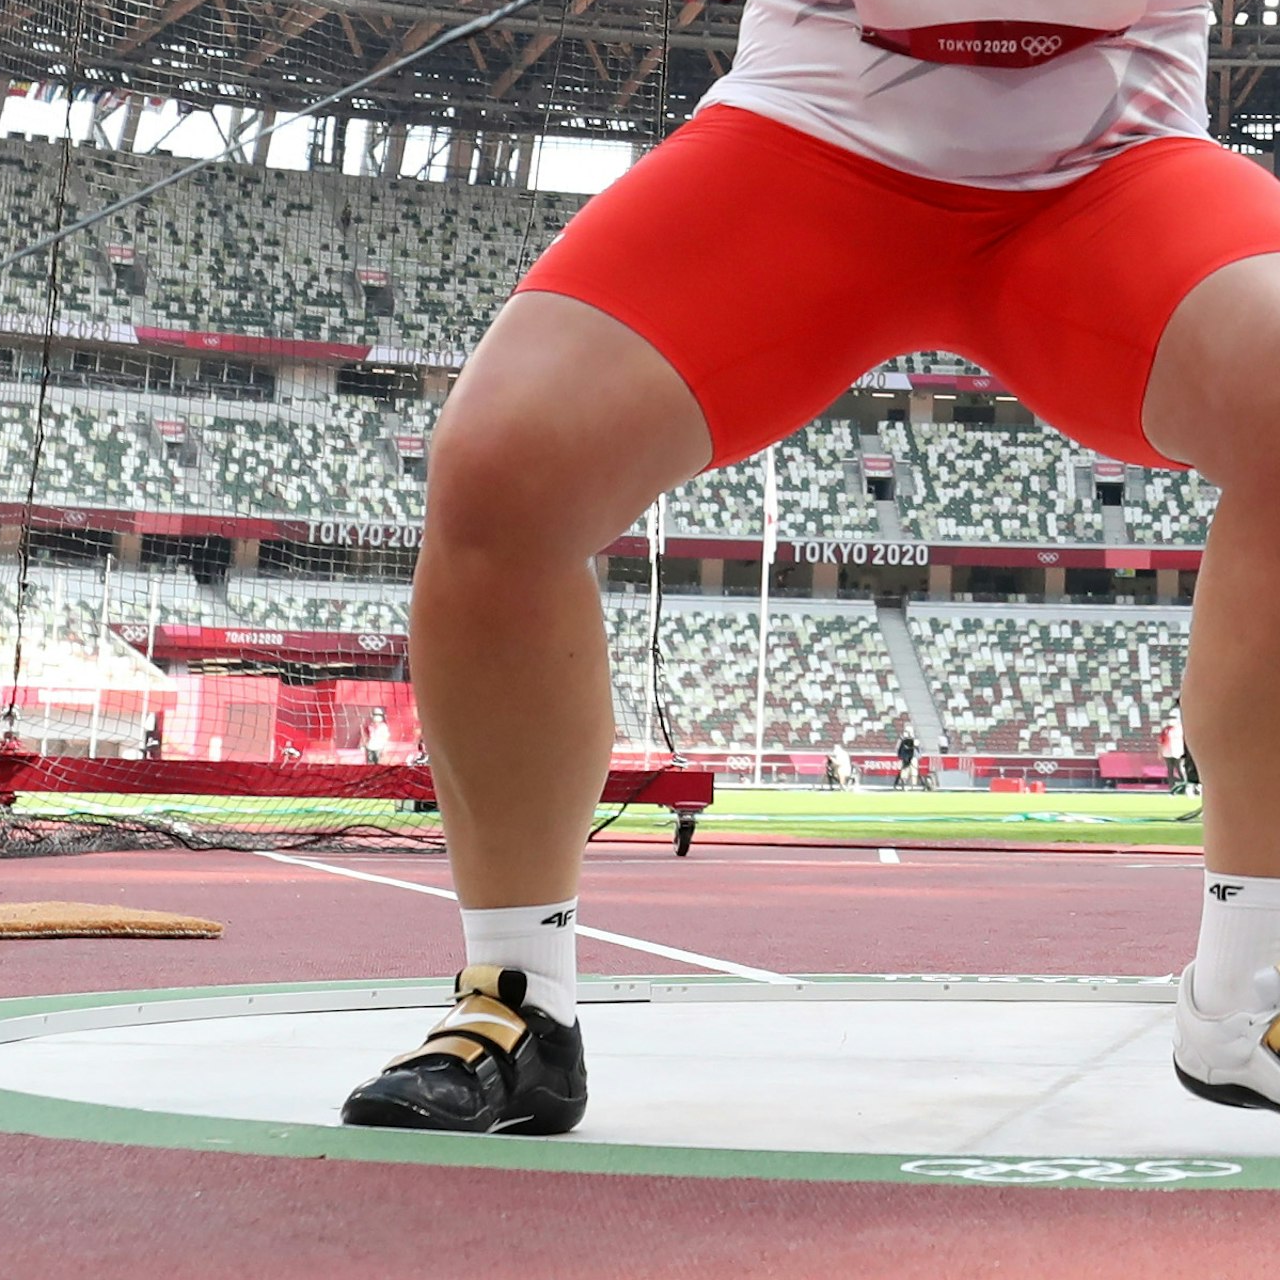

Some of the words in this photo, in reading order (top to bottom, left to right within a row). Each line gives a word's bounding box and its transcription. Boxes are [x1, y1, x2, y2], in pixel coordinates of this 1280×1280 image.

[938, 38, 981, 52] TOKYO
[984, 40, 1018, 54] 2020
[306, 520, 384, 547] TOKYO
[791, 540, 868, 565] TOKYO
[871, 543, 930, 567] 2020
